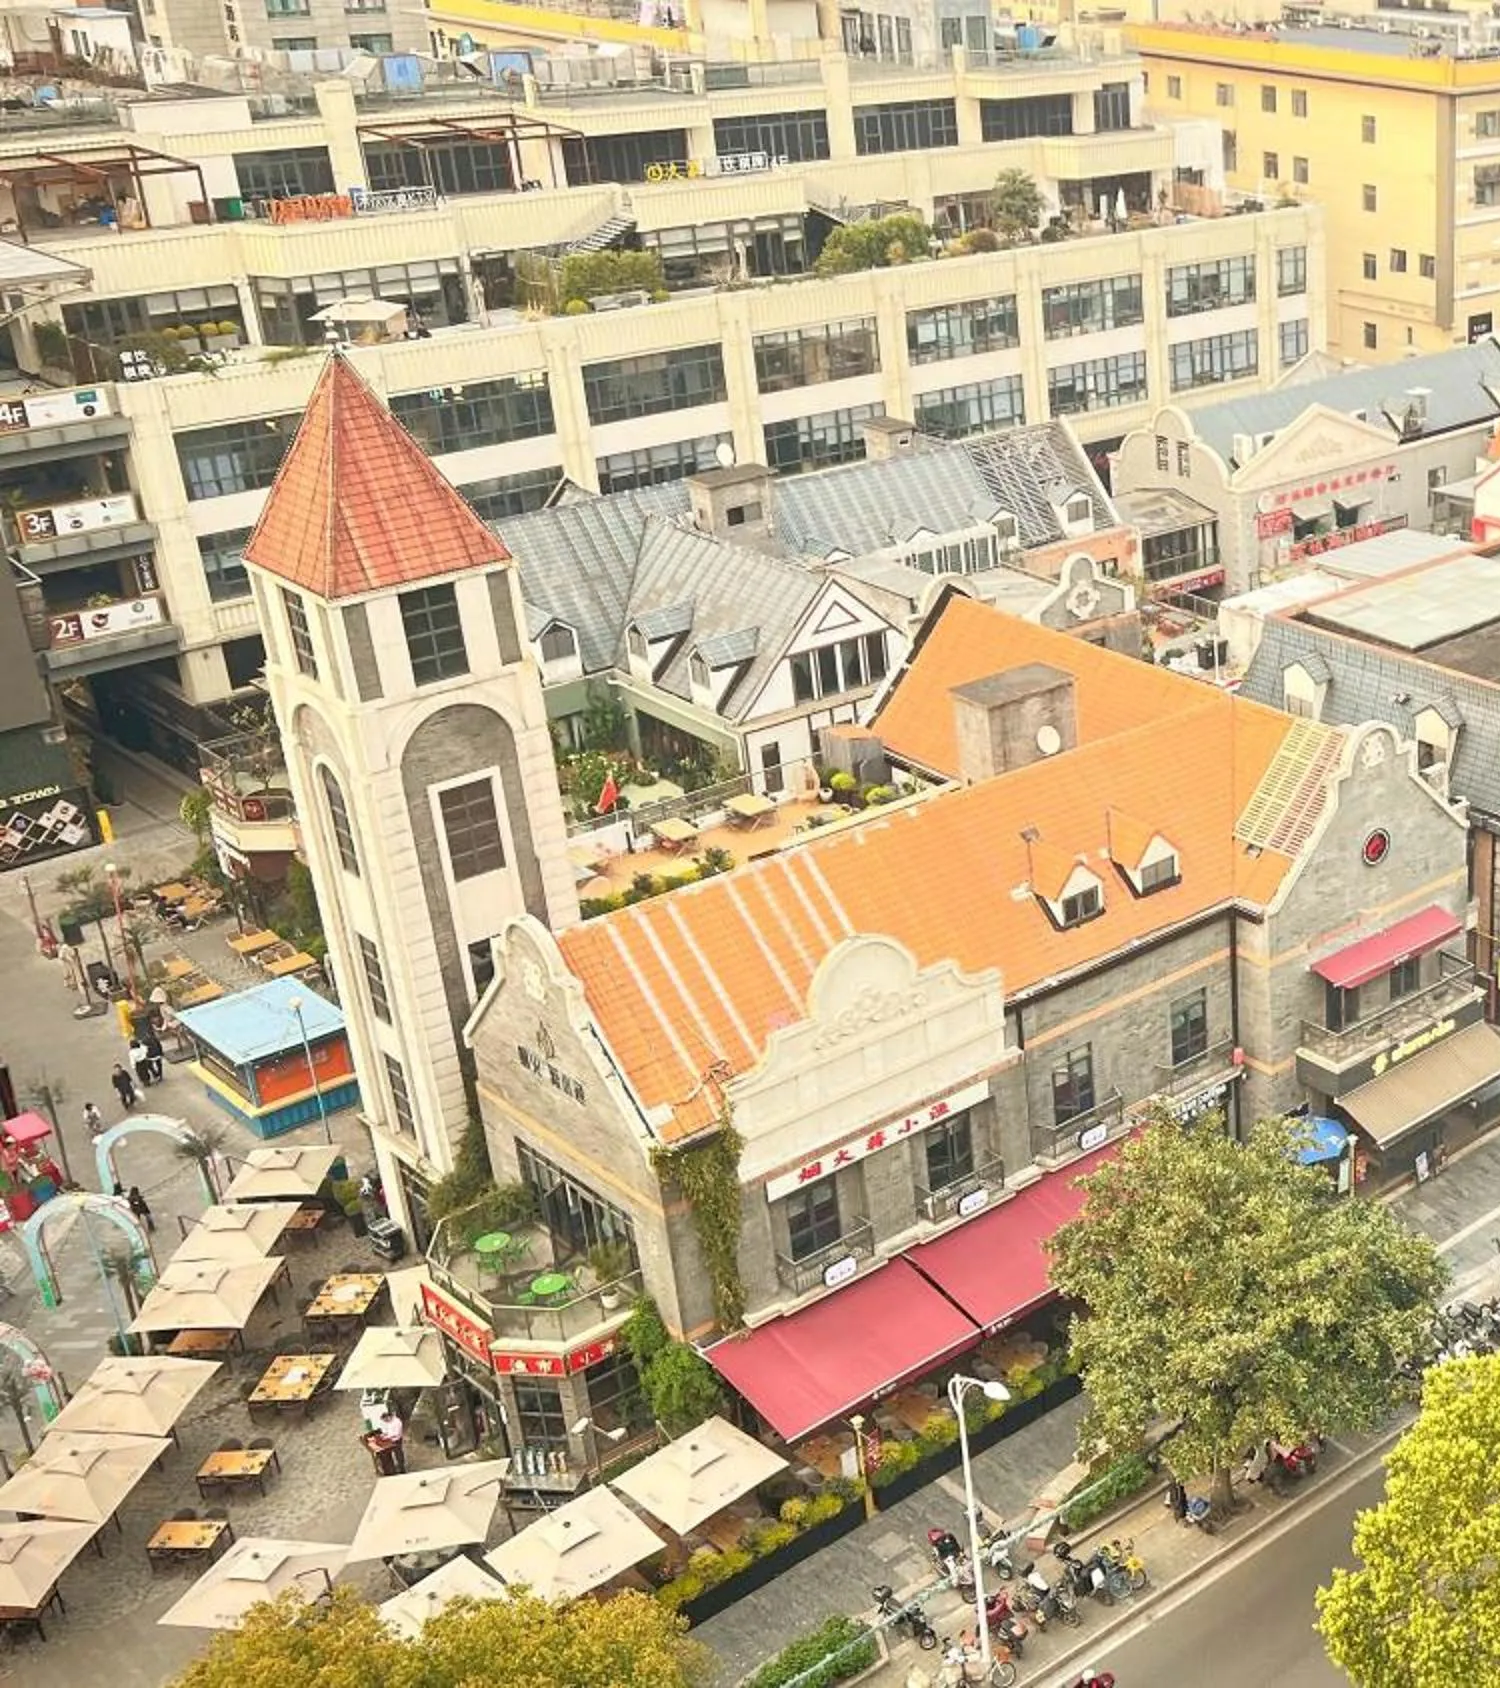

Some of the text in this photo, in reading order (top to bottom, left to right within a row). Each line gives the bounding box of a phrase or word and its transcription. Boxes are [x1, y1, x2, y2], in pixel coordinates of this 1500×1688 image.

[0, 405, 25, 426] 4F
[26, 513, 51, 535] 3F
[53, 618, 79, 640] 2F
